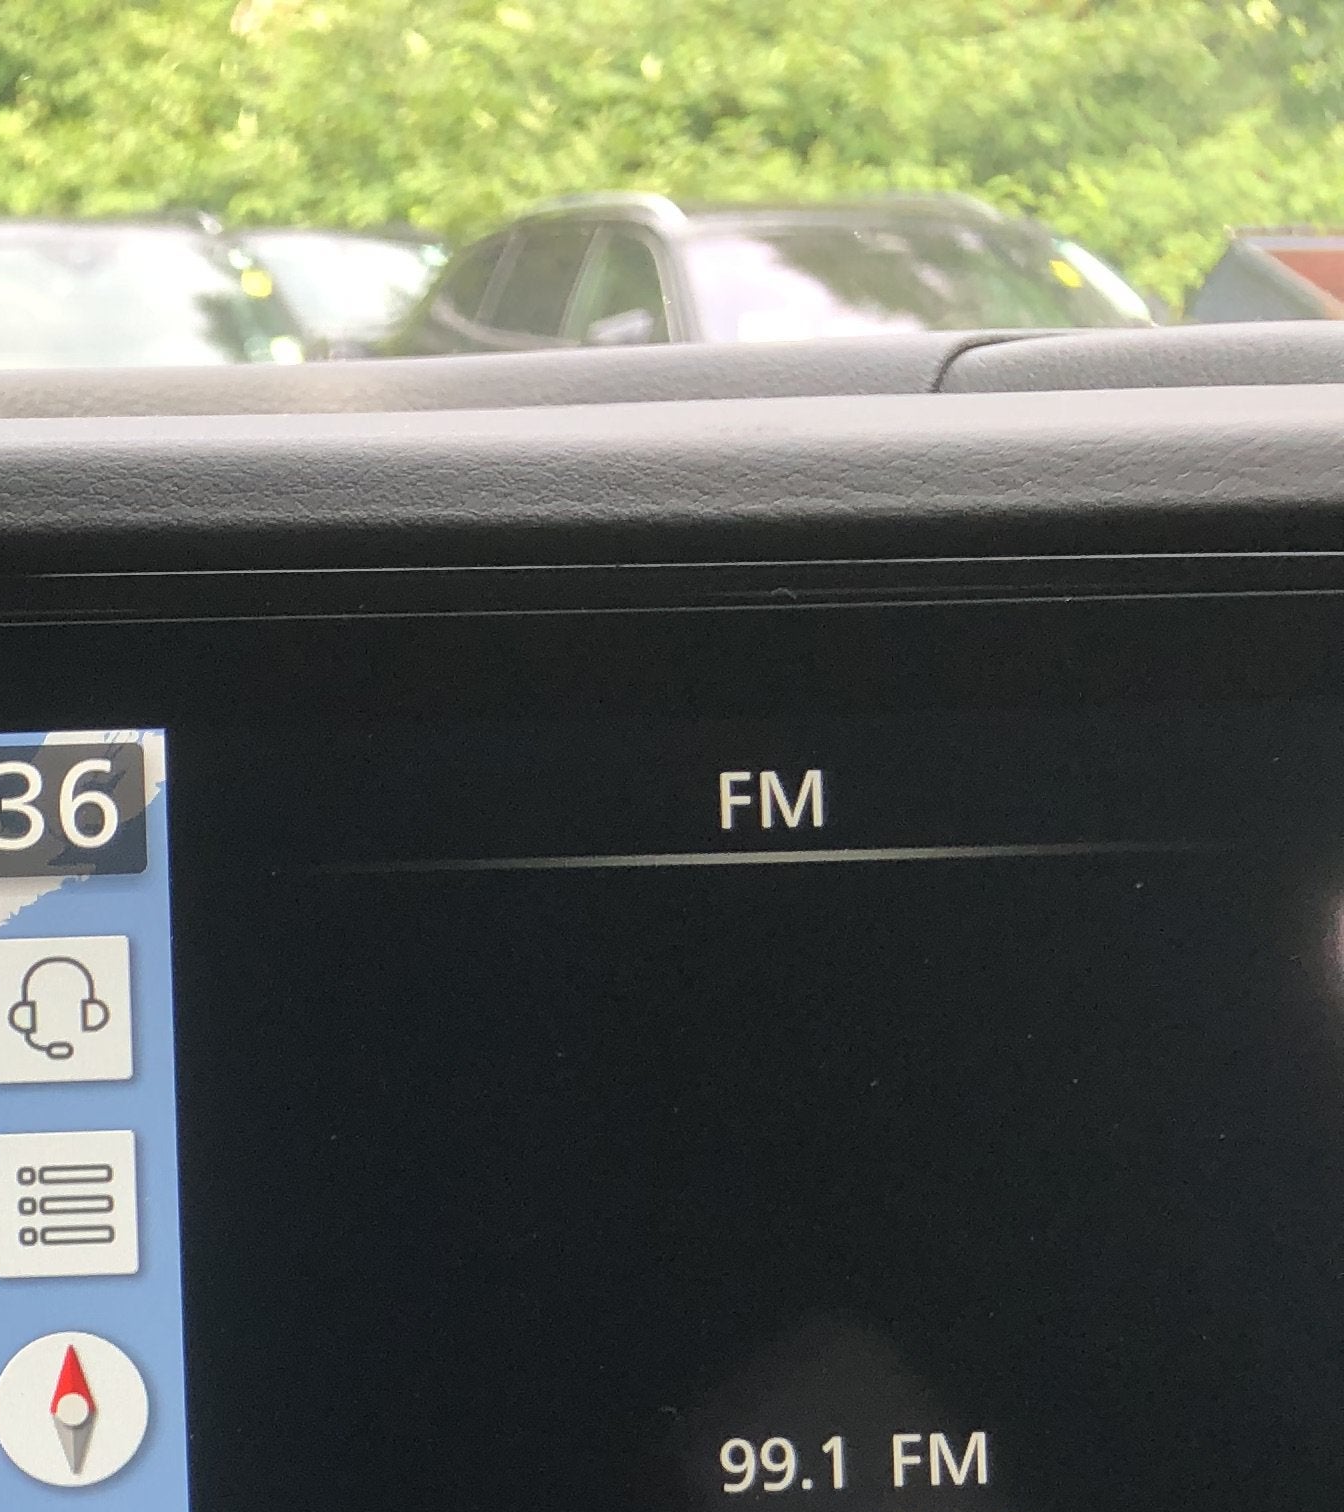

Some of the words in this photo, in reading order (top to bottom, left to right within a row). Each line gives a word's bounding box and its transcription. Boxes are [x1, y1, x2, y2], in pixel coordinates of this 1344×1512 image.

[719, 769, 825, 830] FM
[719, 1435, 846, 1494] 99.1
[891, 1431, 989, 1488] FM
